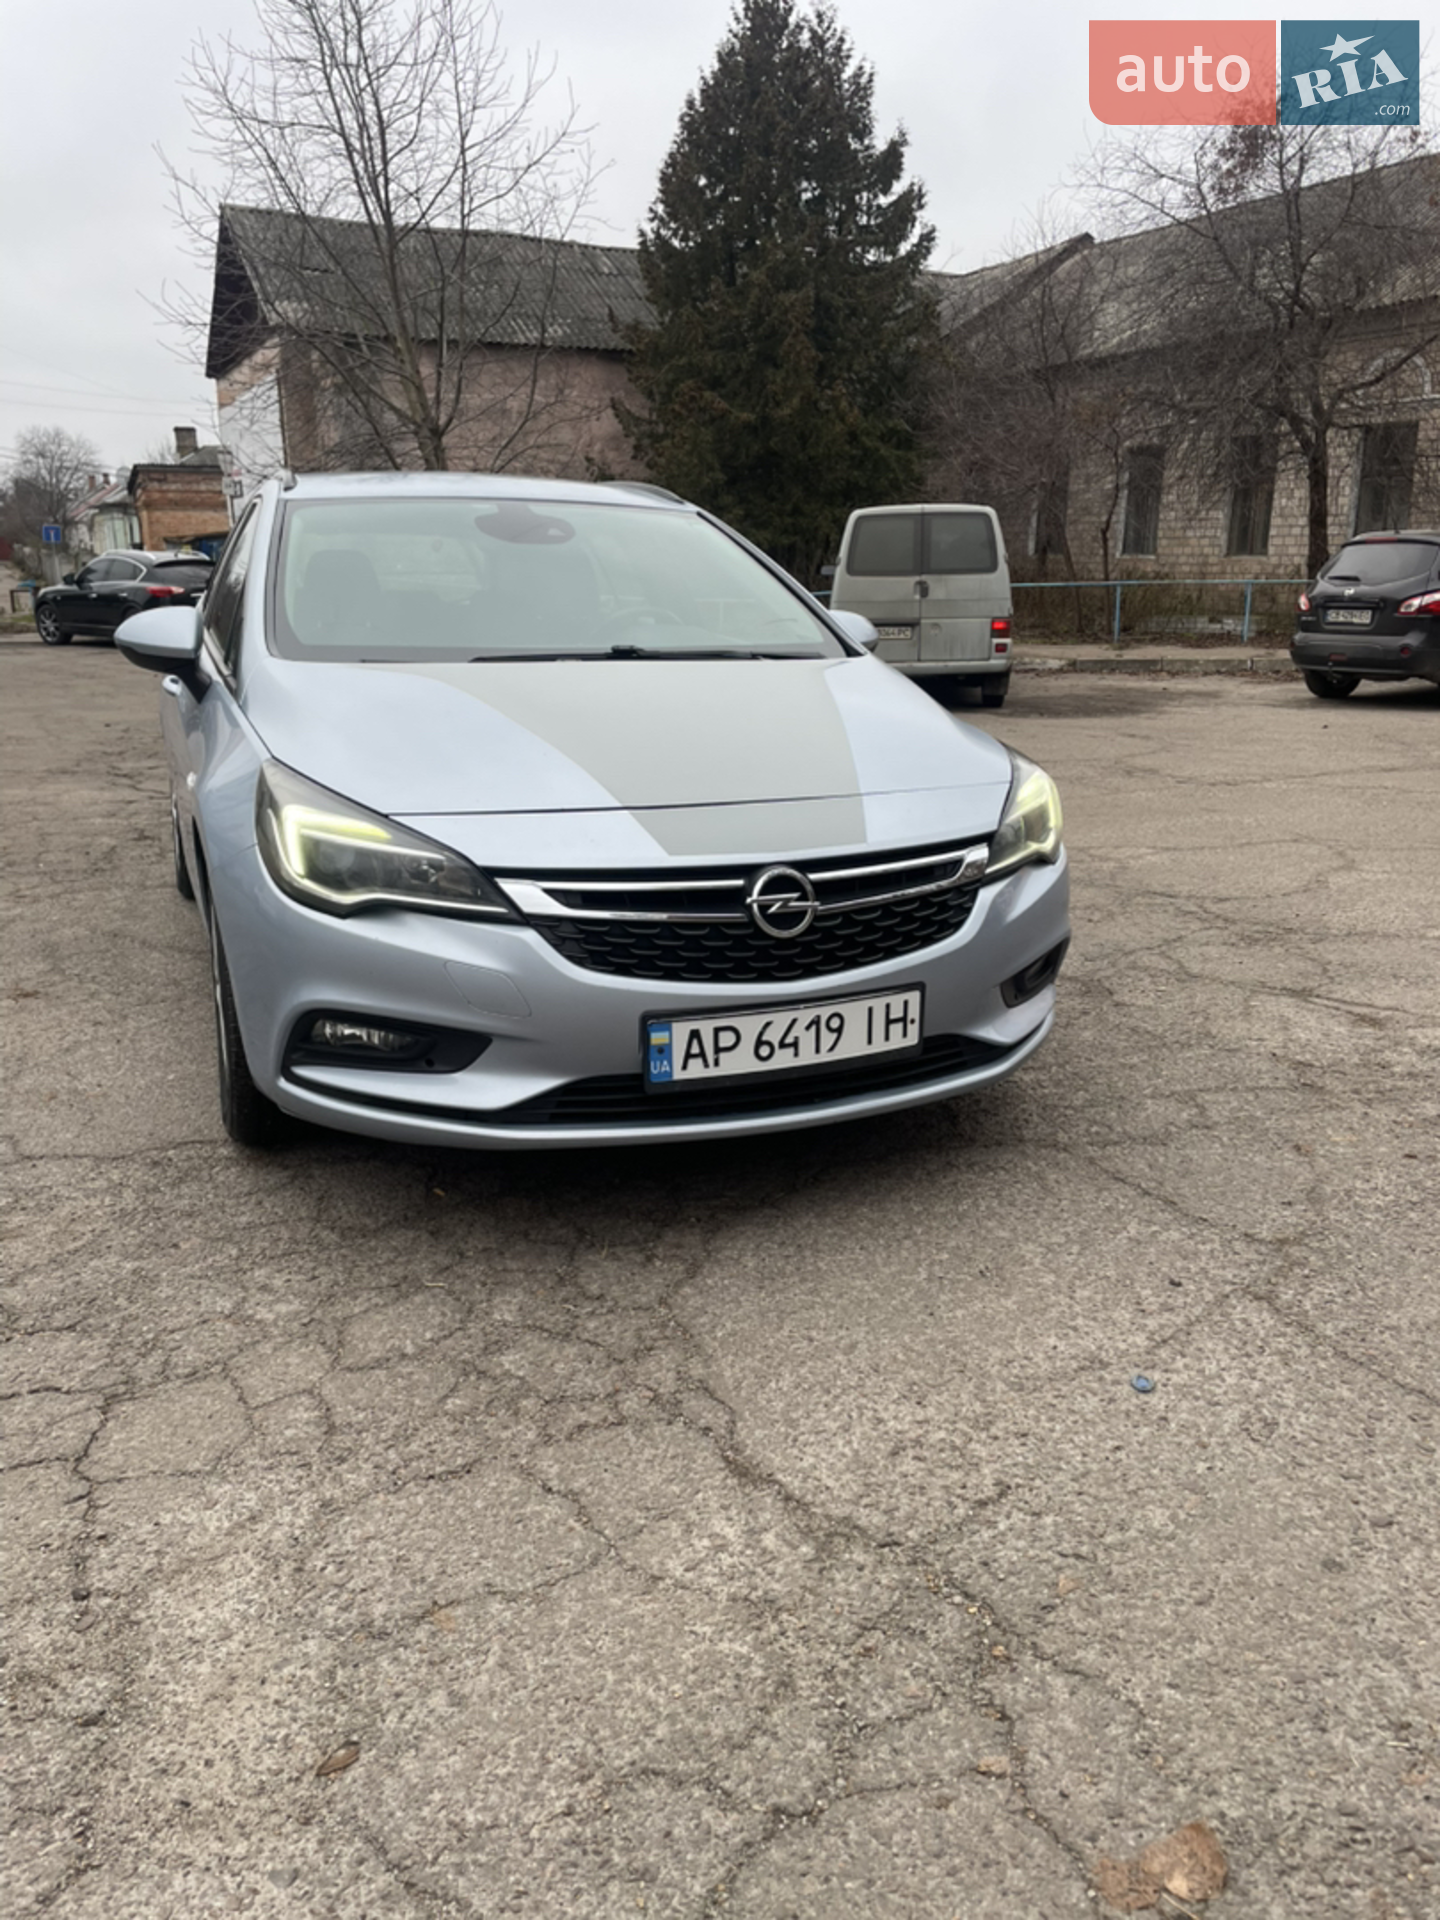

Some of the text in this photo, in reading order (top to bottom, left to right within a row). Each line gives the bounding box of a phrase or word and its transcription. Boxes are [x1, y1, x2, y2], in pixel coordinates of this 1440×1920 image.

[681, 999, 910, 1071] AP 6419 IH
[650, 1059, 671, 1075] UA
